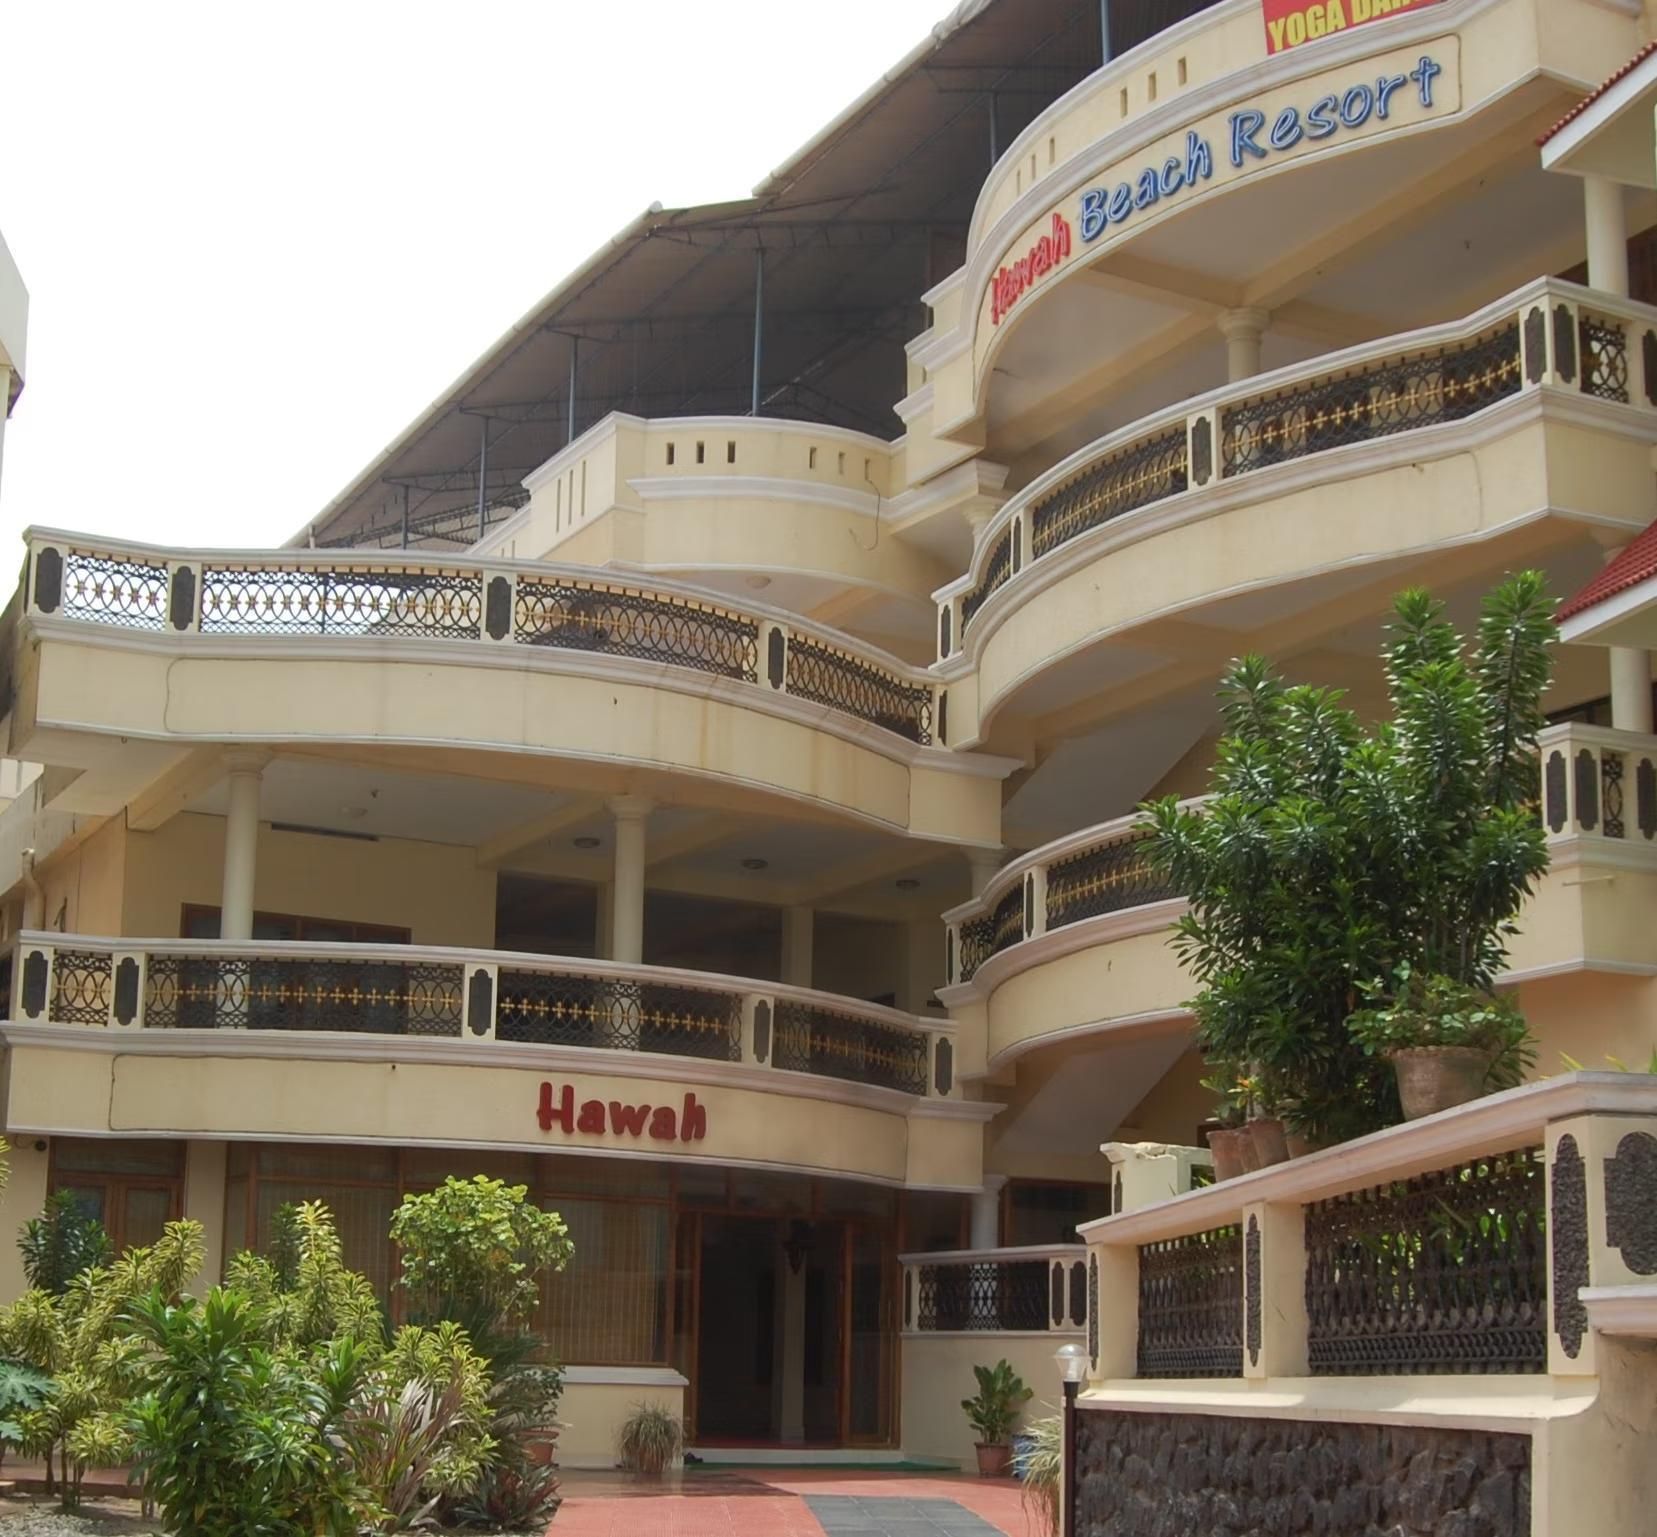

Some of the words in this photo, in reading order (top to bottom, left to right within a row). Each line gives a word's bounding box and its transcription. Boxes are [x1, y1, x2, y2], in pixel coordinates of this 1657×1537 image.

[1268, 0, 1346, 51] YOGA
[991, 213, 1071, 325] Hawah
[1080, 131, 1212, 242] Beach
[1229, 56, 1441, 168] Resort
[536, 1081, 707, 1142] Hawah
